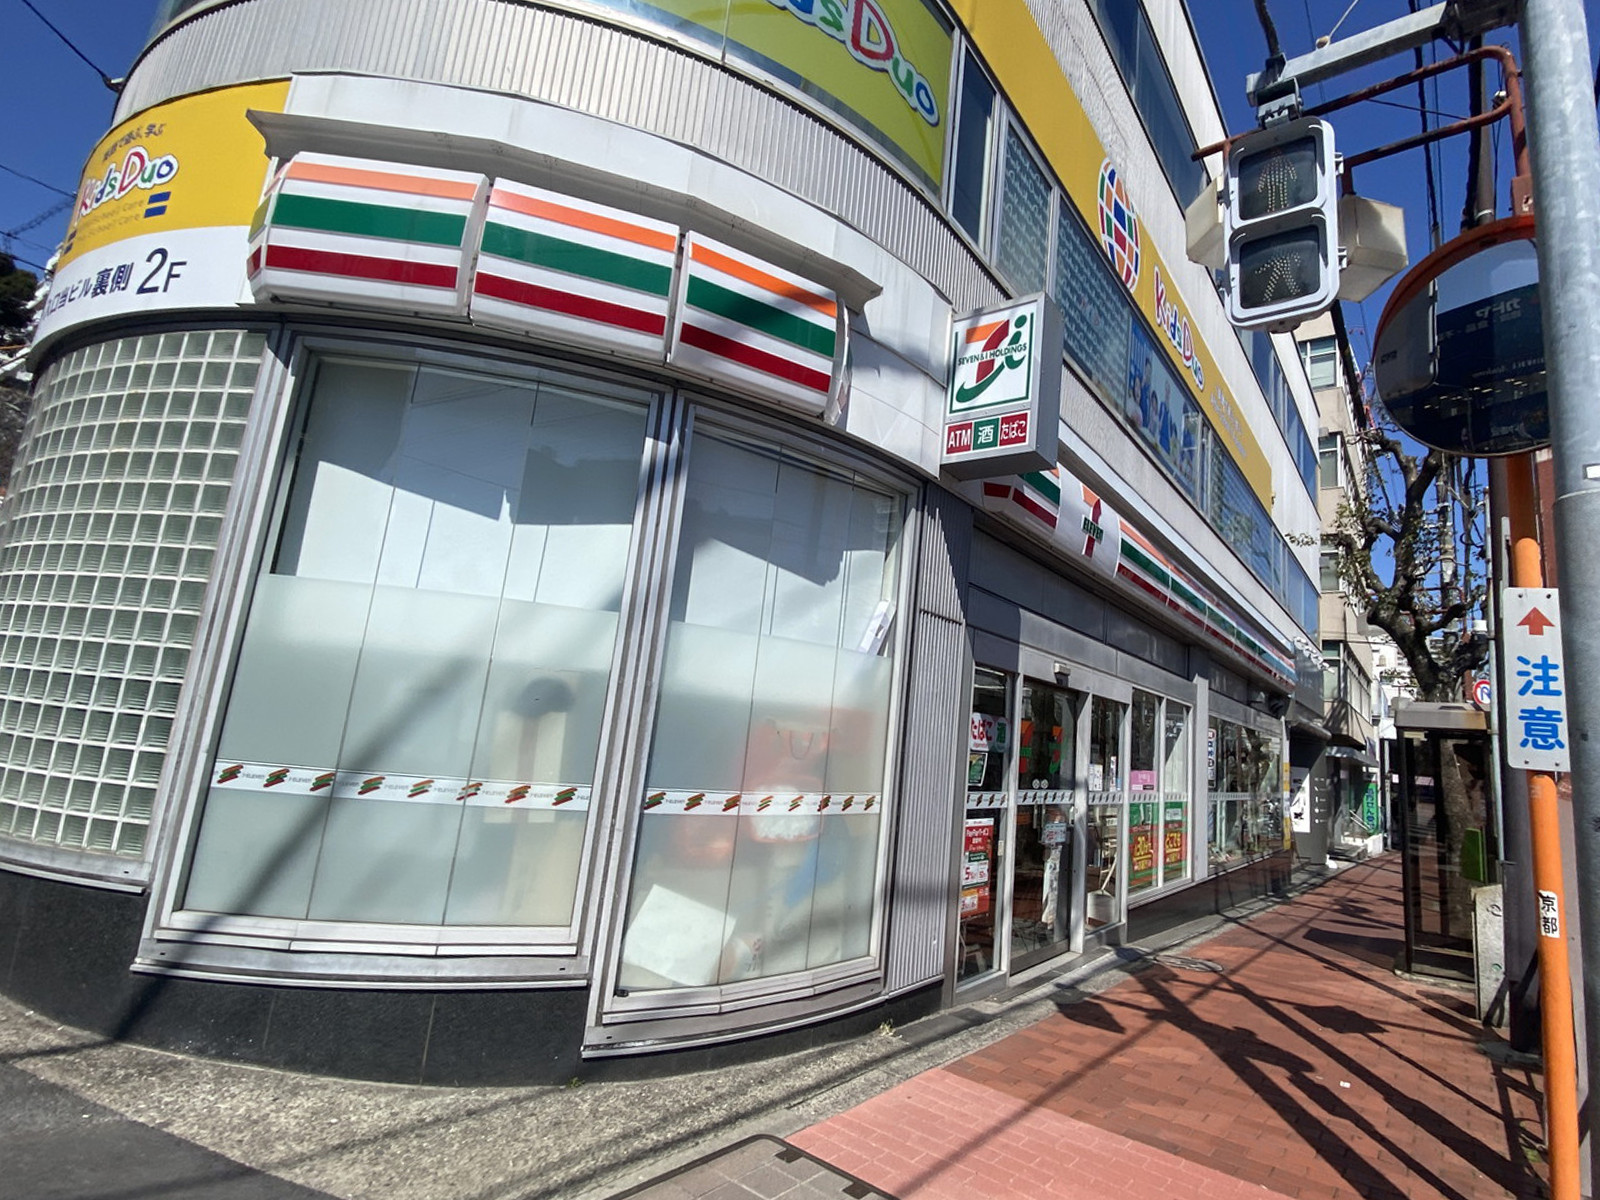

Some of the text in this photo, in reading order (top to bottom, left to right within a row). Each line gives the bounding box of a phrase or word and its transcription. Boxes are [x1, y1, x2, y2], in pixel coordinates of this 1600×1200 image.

[136, 247, 187, 295] 2F
[989, 342, 1027, 359] HOLDINGS
[949, 419, 1026, 449] ATM 酒 たばこ
[1516, 655, 1565, 750] 注意
